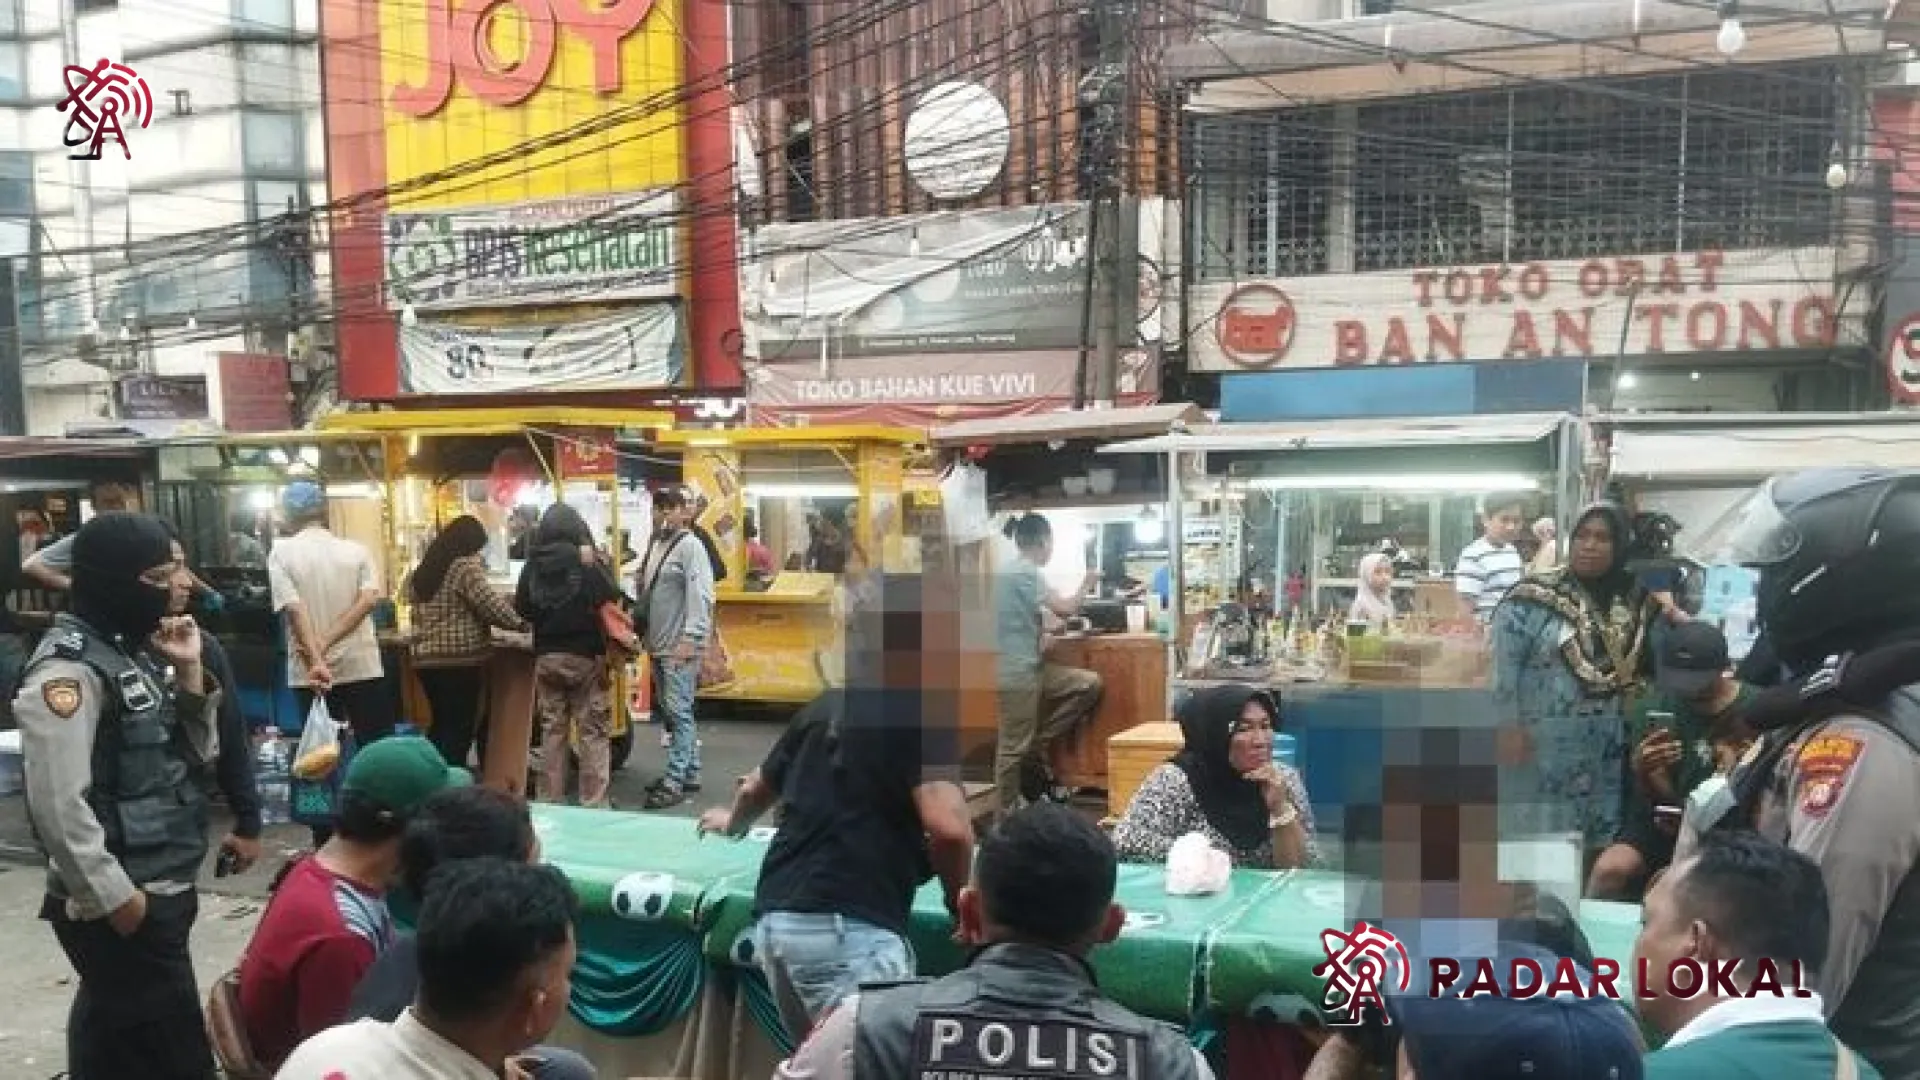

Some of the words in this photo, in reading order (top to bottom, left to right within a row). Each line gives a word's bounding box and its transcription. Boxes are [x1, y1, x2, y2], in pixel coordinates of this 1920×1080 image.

[390, 0, 655, 118] JOY
[1412, 262, 1548, 307] TOKO
[1579, 246, 1724, 297] OBAT
[1332, 312, 1466, 366] BAN
[1502, 306, 1595, 357] AN
[1634, 292, 1840, 351] TONG
[793, 380, 854, 399] TOKO
[860, 376, 935, 399] BAHAN
[939, 373, 984, 397] KUE
[989, 371, 1036, 395] VIVI
[929, 1019, 1138, 1080] POLISI
